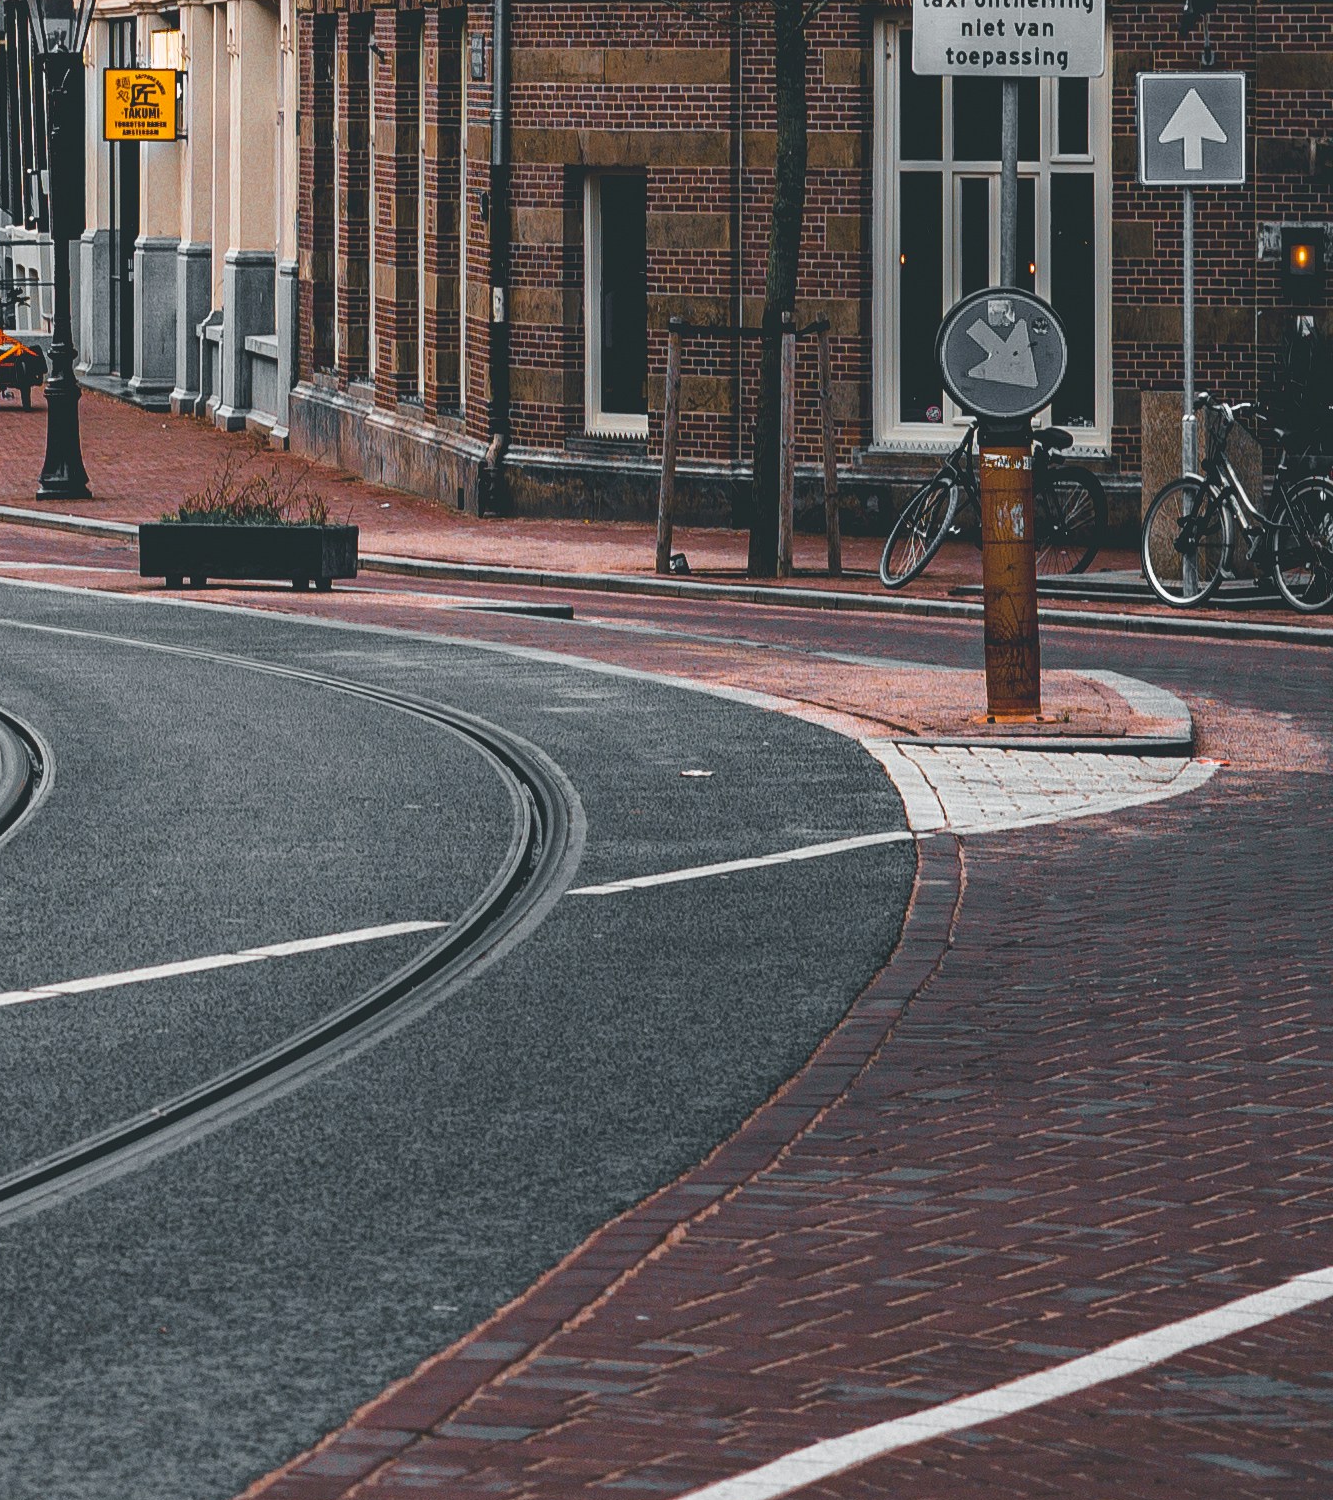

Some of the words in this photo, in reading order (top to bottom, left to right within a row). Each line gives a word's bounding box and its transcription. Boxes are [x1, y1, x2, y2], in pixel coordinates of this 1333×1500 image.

[961, 18, 1006, 37] niet
[1014, 21, 1055, 37] van
[945, 46, 1069, 71] toepassing
[123, 107, 160, 119] TAKUMI
